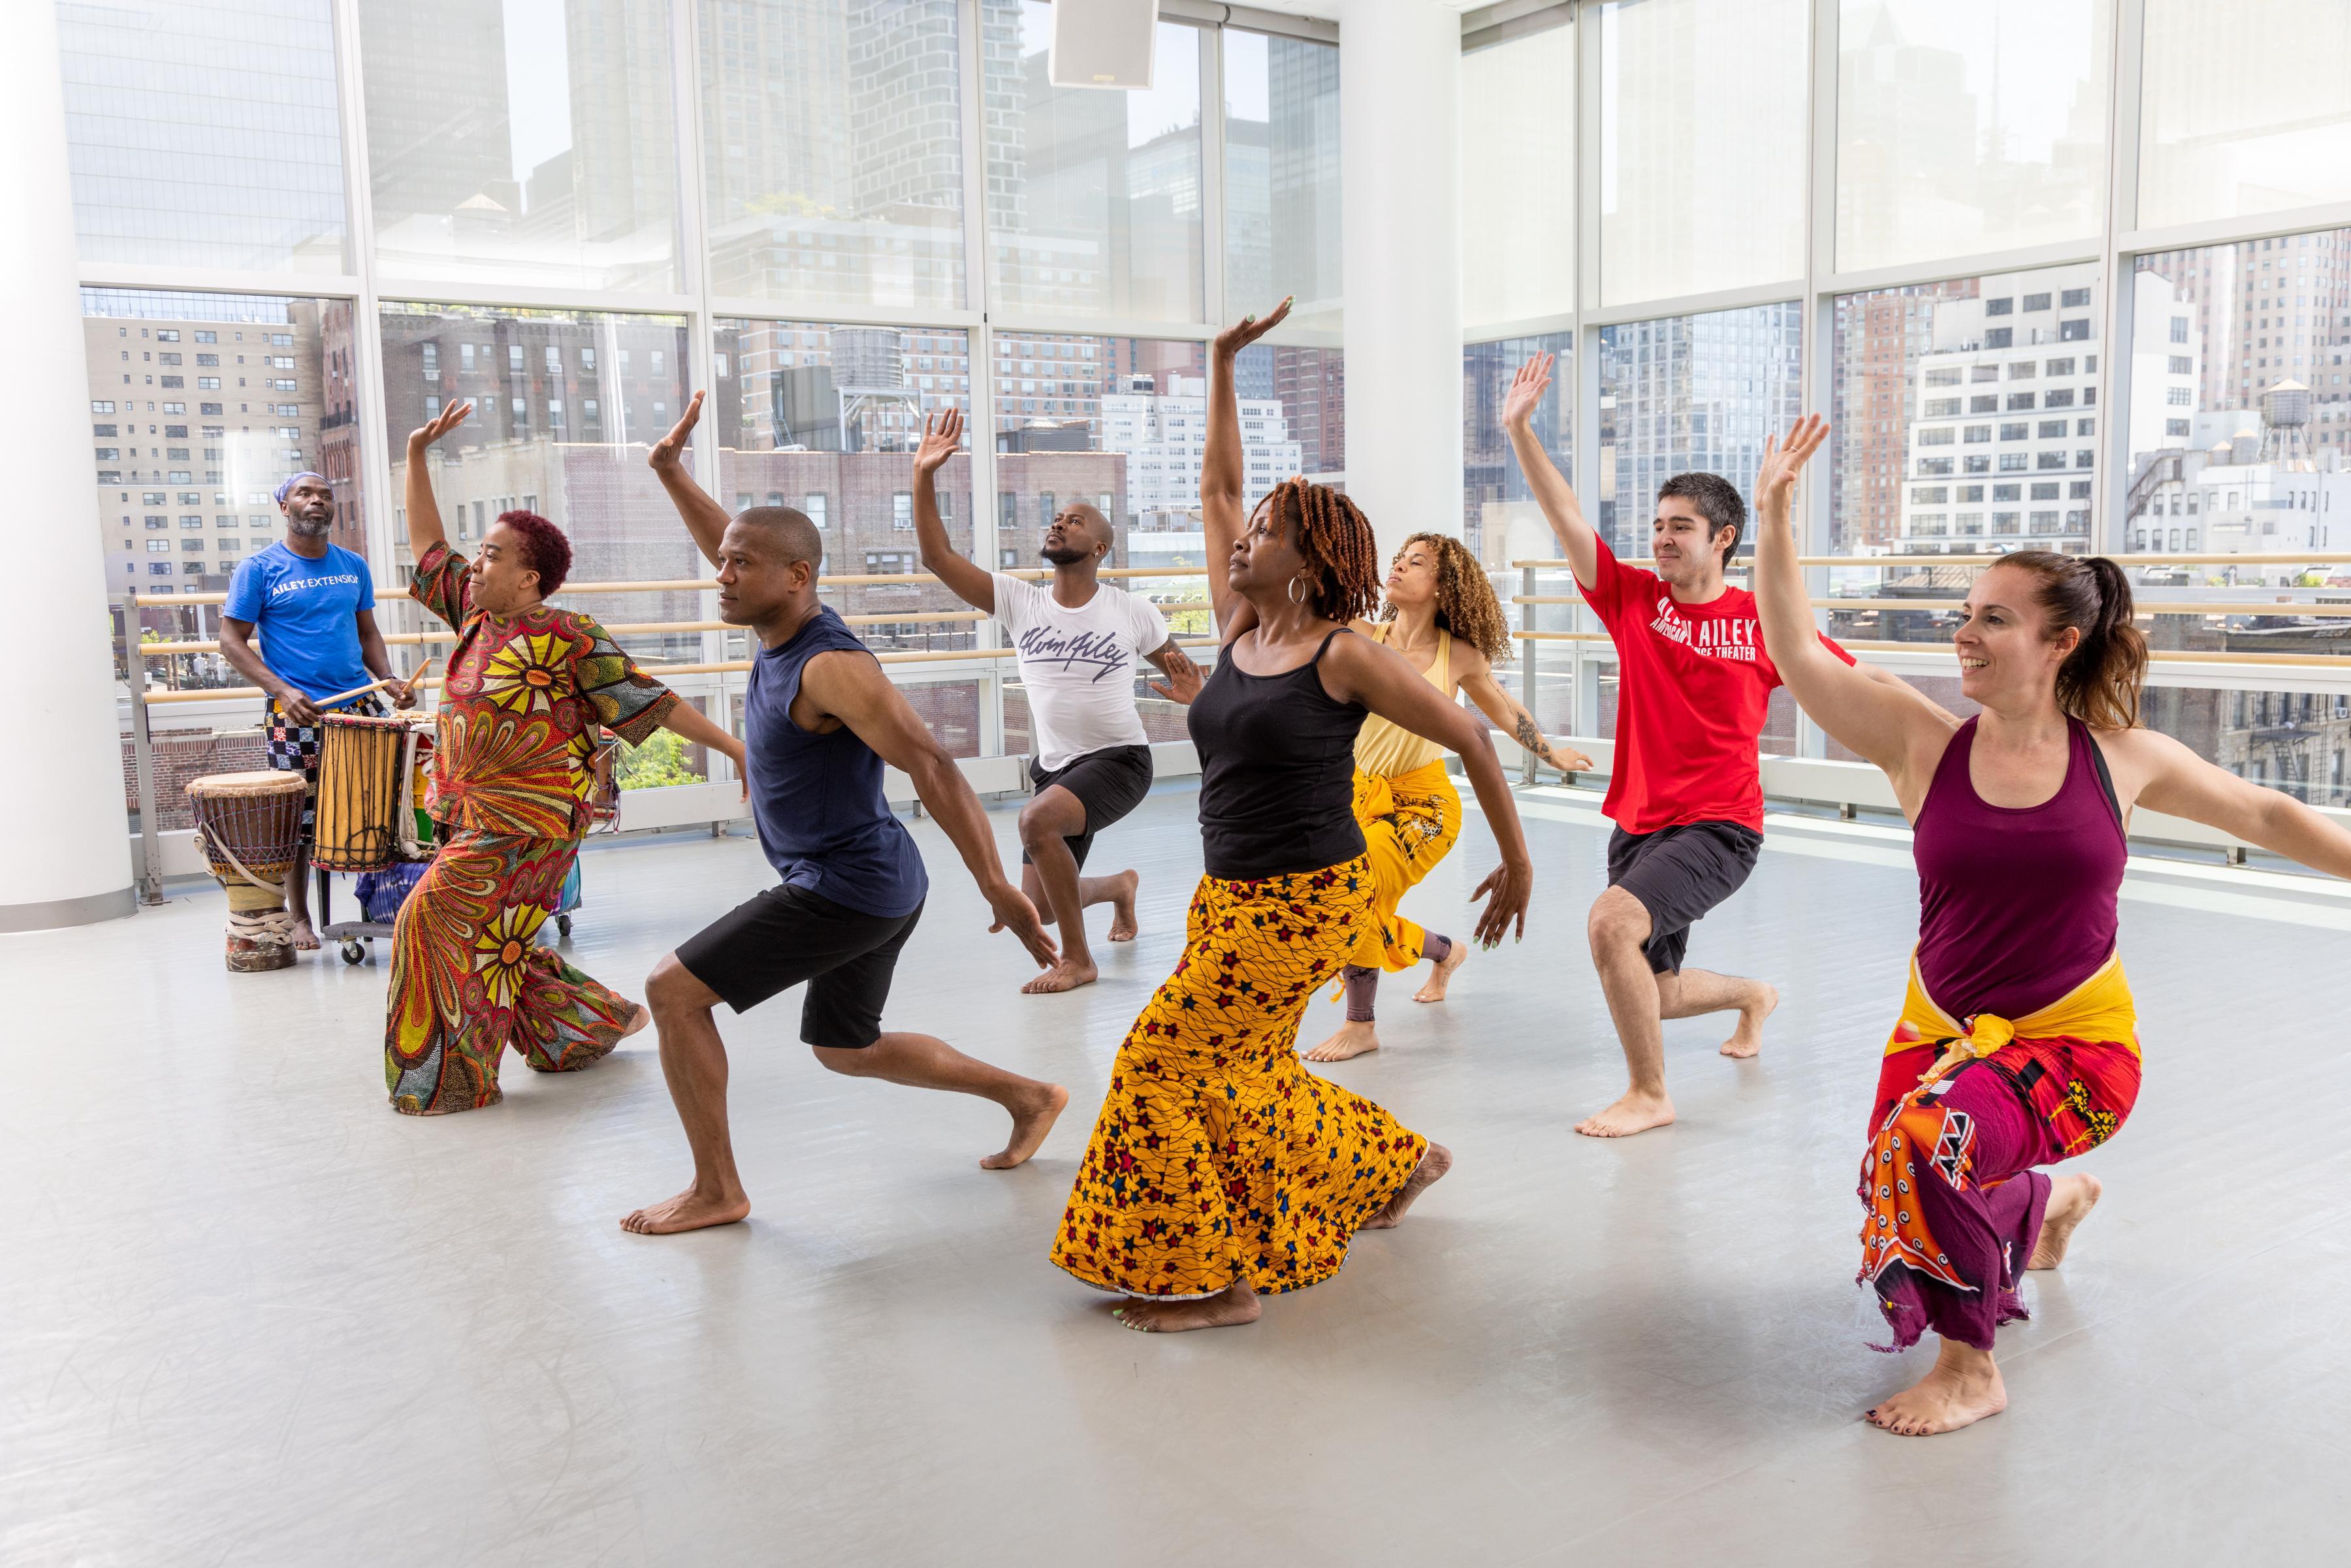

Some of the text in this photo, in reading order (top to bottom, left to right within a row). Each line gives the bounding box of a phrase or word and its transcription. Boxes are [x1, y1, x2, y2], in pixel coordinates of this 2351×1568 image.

[1650, 616, 1687, 644] AMERICAN
[1715, 646, 1755, 661] THEATER
[1657, 596, 1692, 643] ALN
